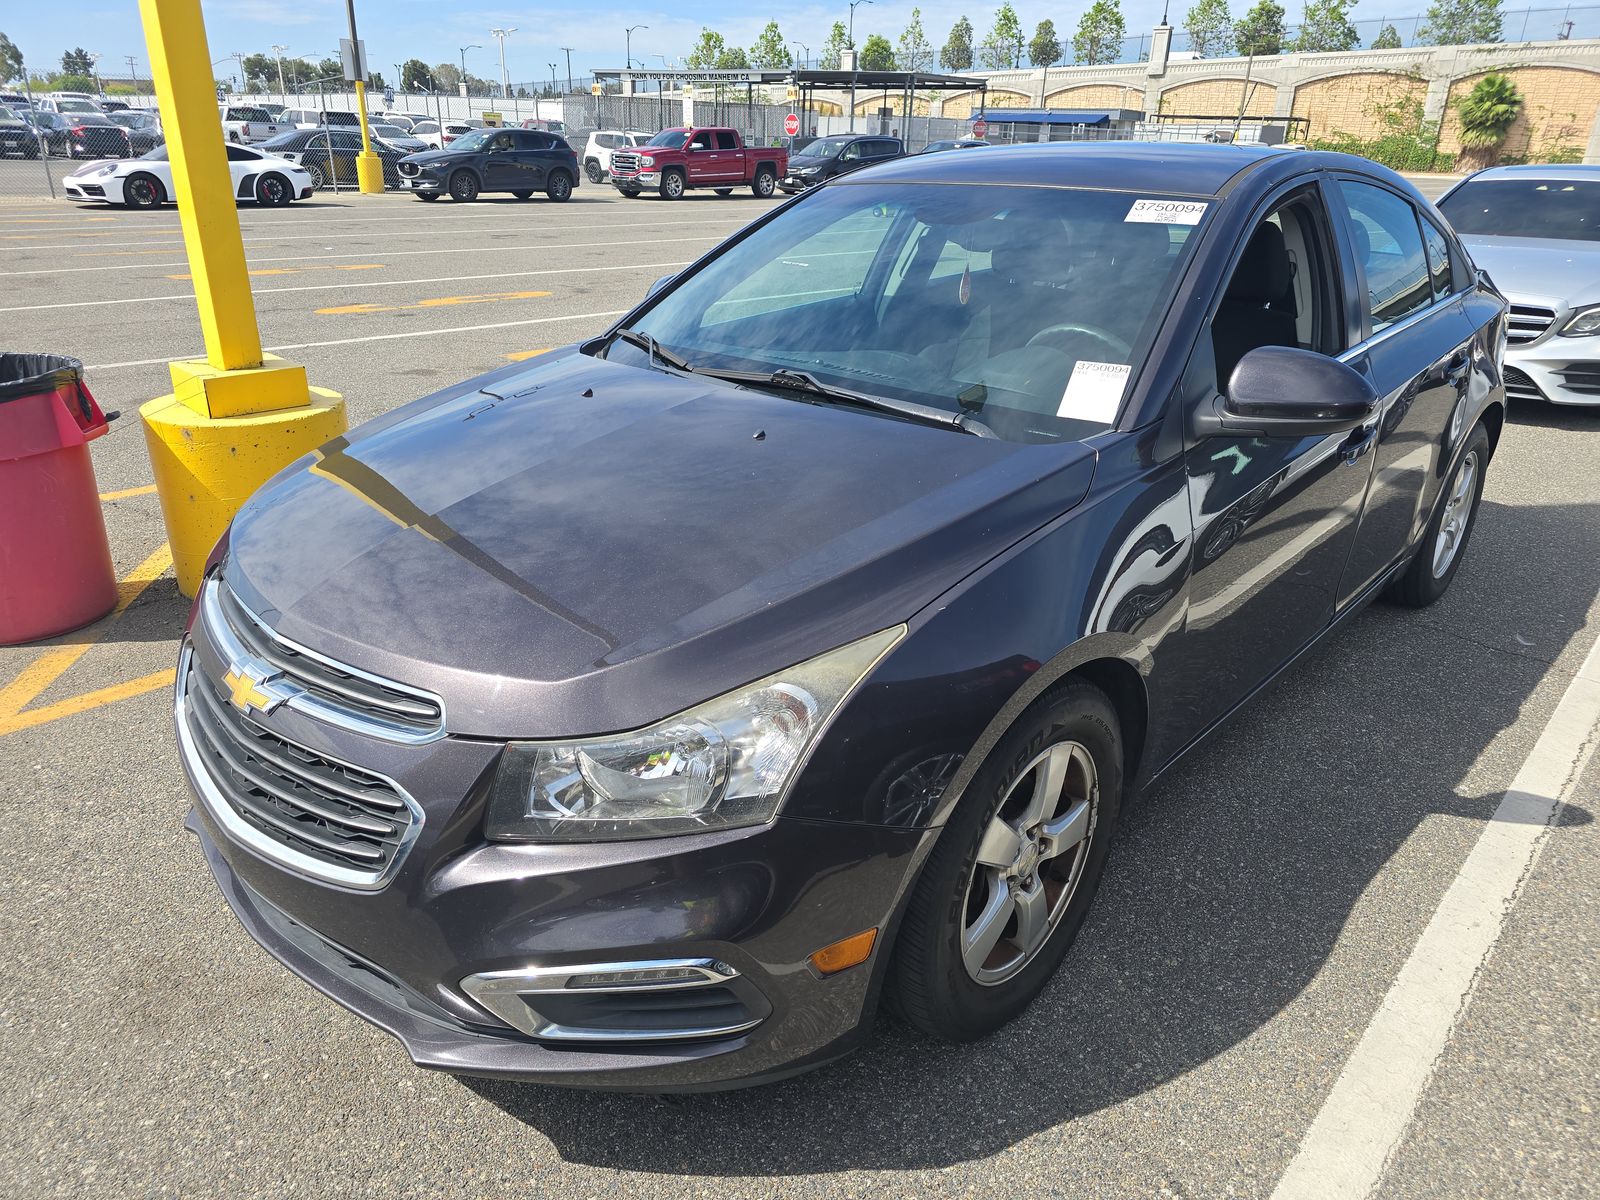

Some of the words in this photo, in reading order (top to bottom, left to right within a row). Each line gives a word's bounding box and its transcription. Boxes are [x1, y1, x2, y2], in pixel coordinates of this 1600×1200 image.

[628, 73, 648, 81] THANK
[649, 73, 661, 81] YOU
[662, 73, 674, 82] FOR
[675, 73, 707, 82] CHOOSING
[708, 73, 739, 82] MANHEIM
[740, 73, 750, 82] CA
[786, 120, 799, 128] STOP
[1134, 201, 1205, 214] 3750094
[1077, 362, 1129, 374] 3750094
